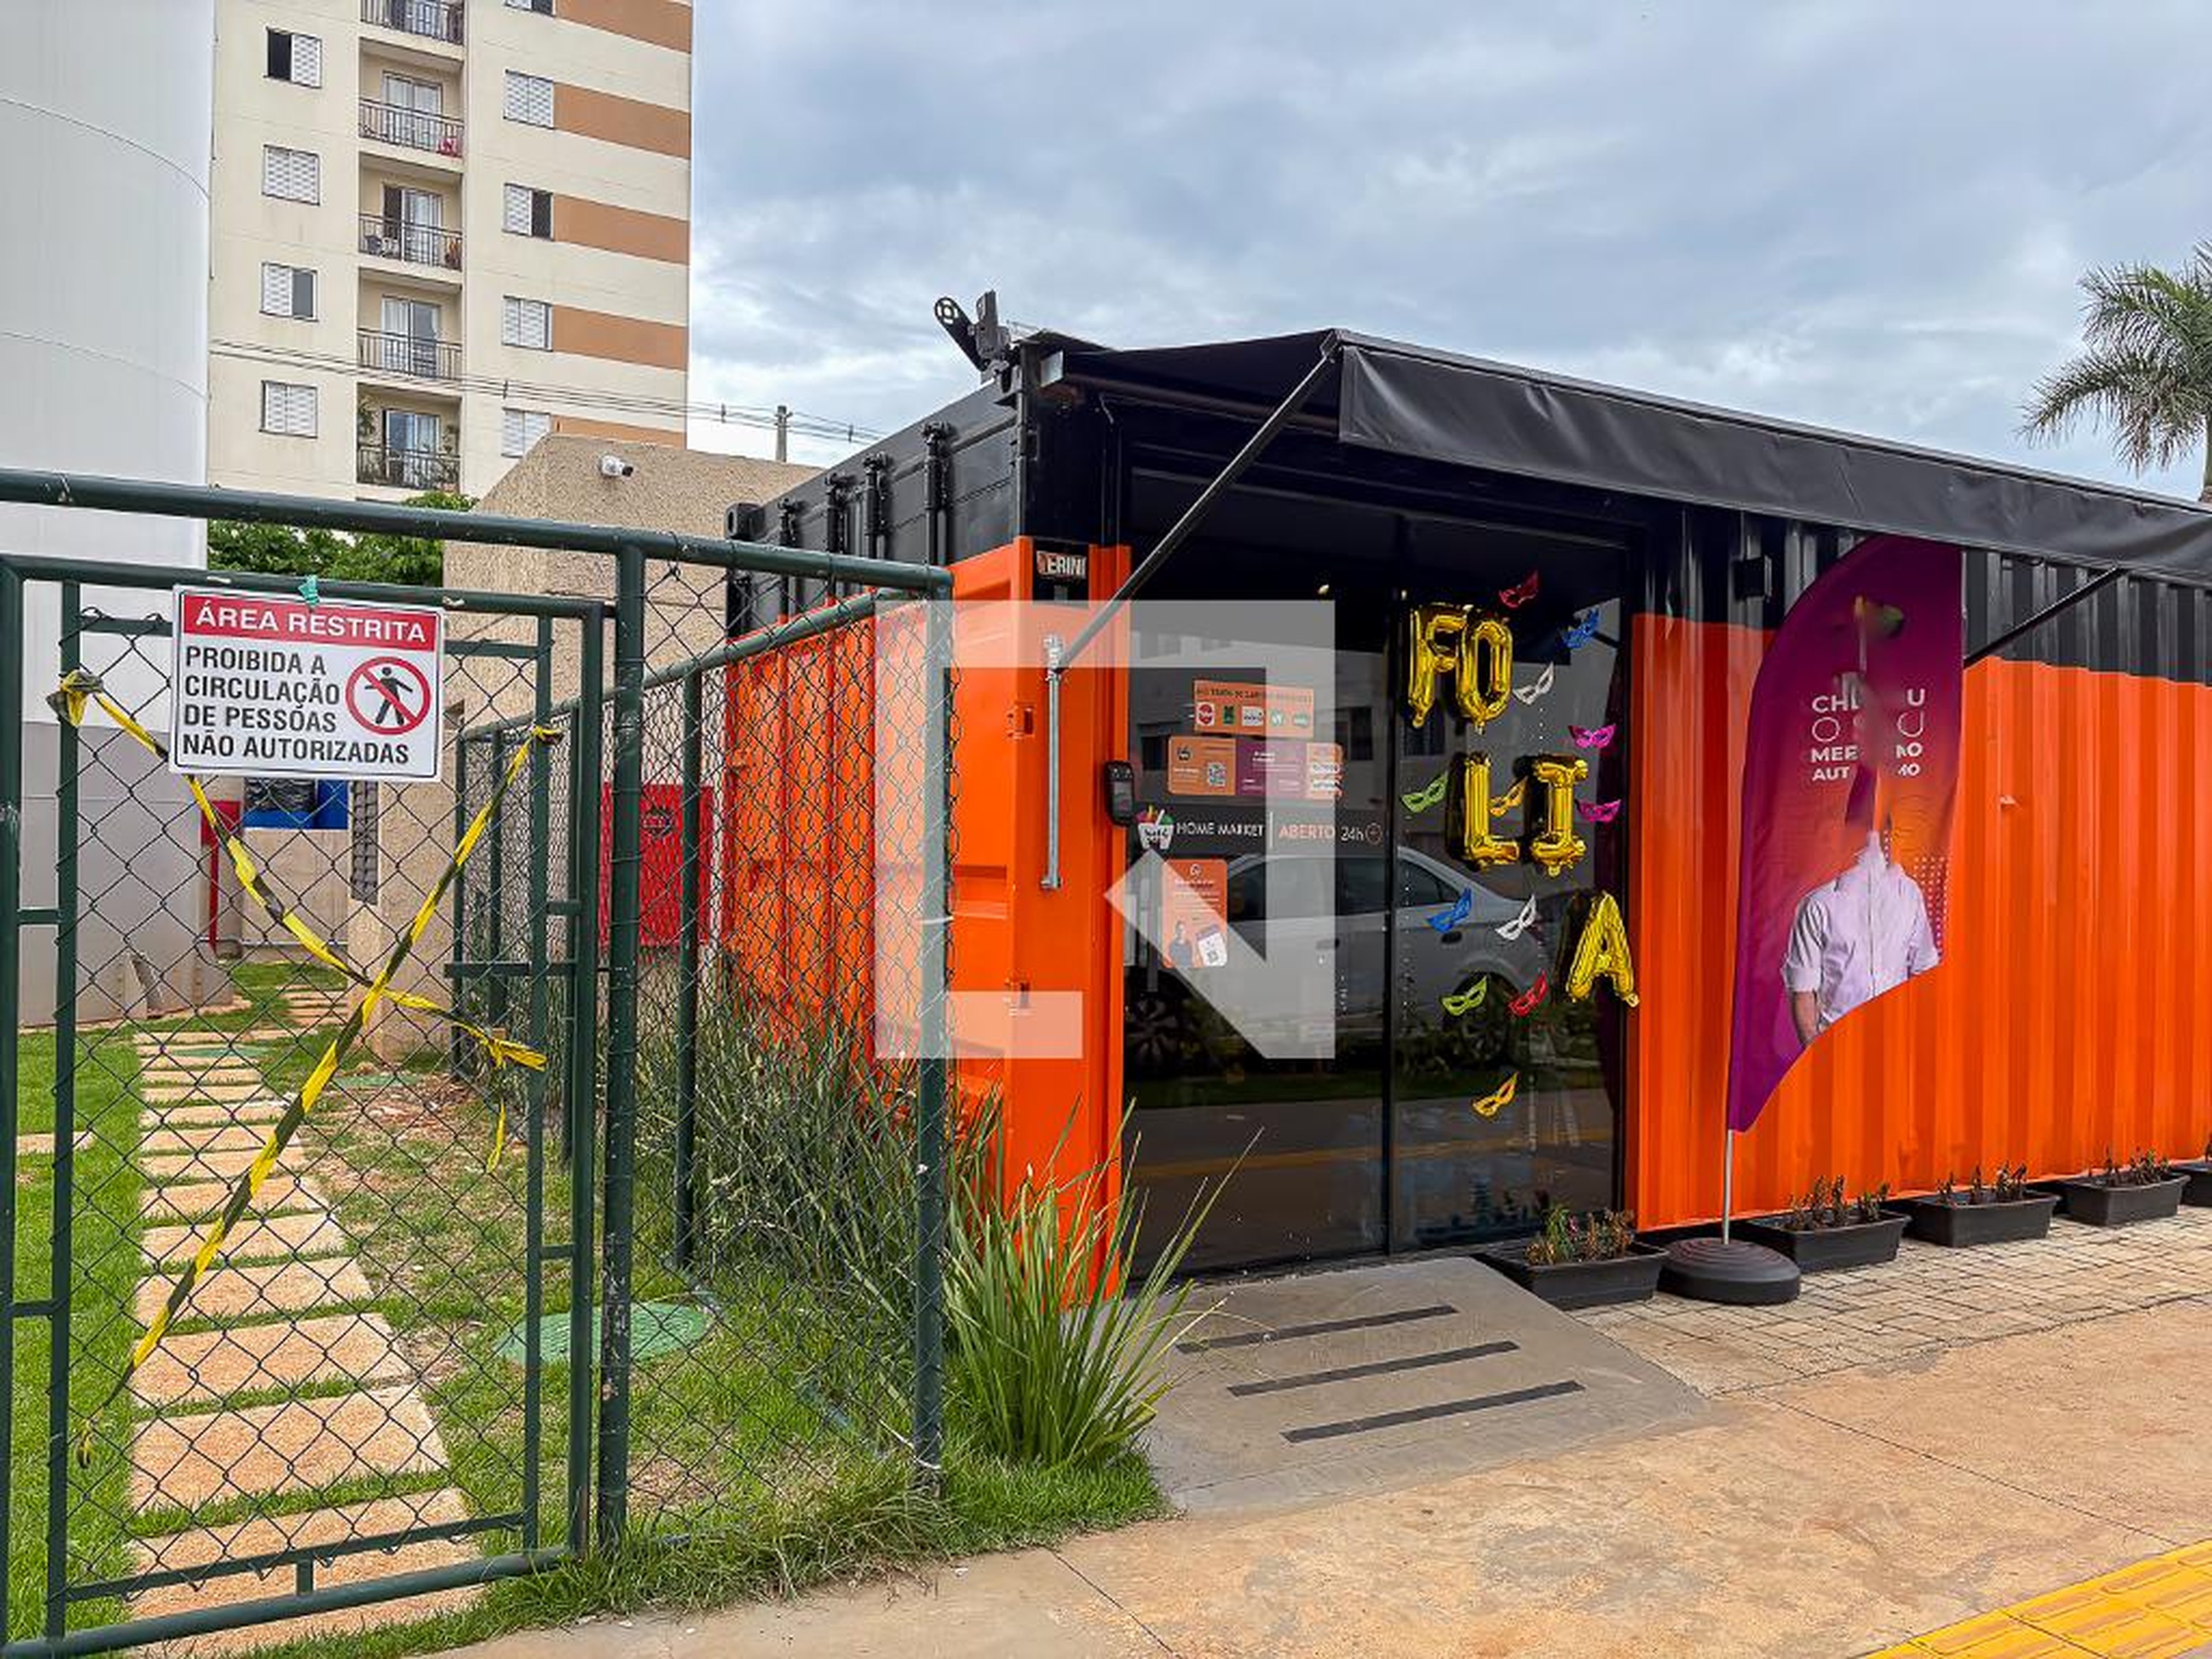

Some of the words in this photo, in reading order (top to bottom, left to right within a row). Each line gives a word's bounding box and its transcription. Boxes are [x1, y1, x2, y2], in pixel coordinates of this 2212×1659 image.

[195, 599, 279, 631] ÁREA
[288, 613, 427, 643] RESTRITA
[185, 646, 303, 674] PROIBIDA
[309, 655, 327, 676] A
[184, 675, 340, 709] CIRCULAÇÃO
[183, 704, 215, 727] DE
[225, 708, 337, 733] PESSOAS
[182, 730, 234, 757] NÃO
[243, 738, 410, 764] AUTORIZADAS
[1176, 821, 1214, 836] HOME
[1217, 823, 1264, 838] MARKET
[1278, 824, 1335, 839] ABERTO
[1340, 825, 1365, 842] 24h
